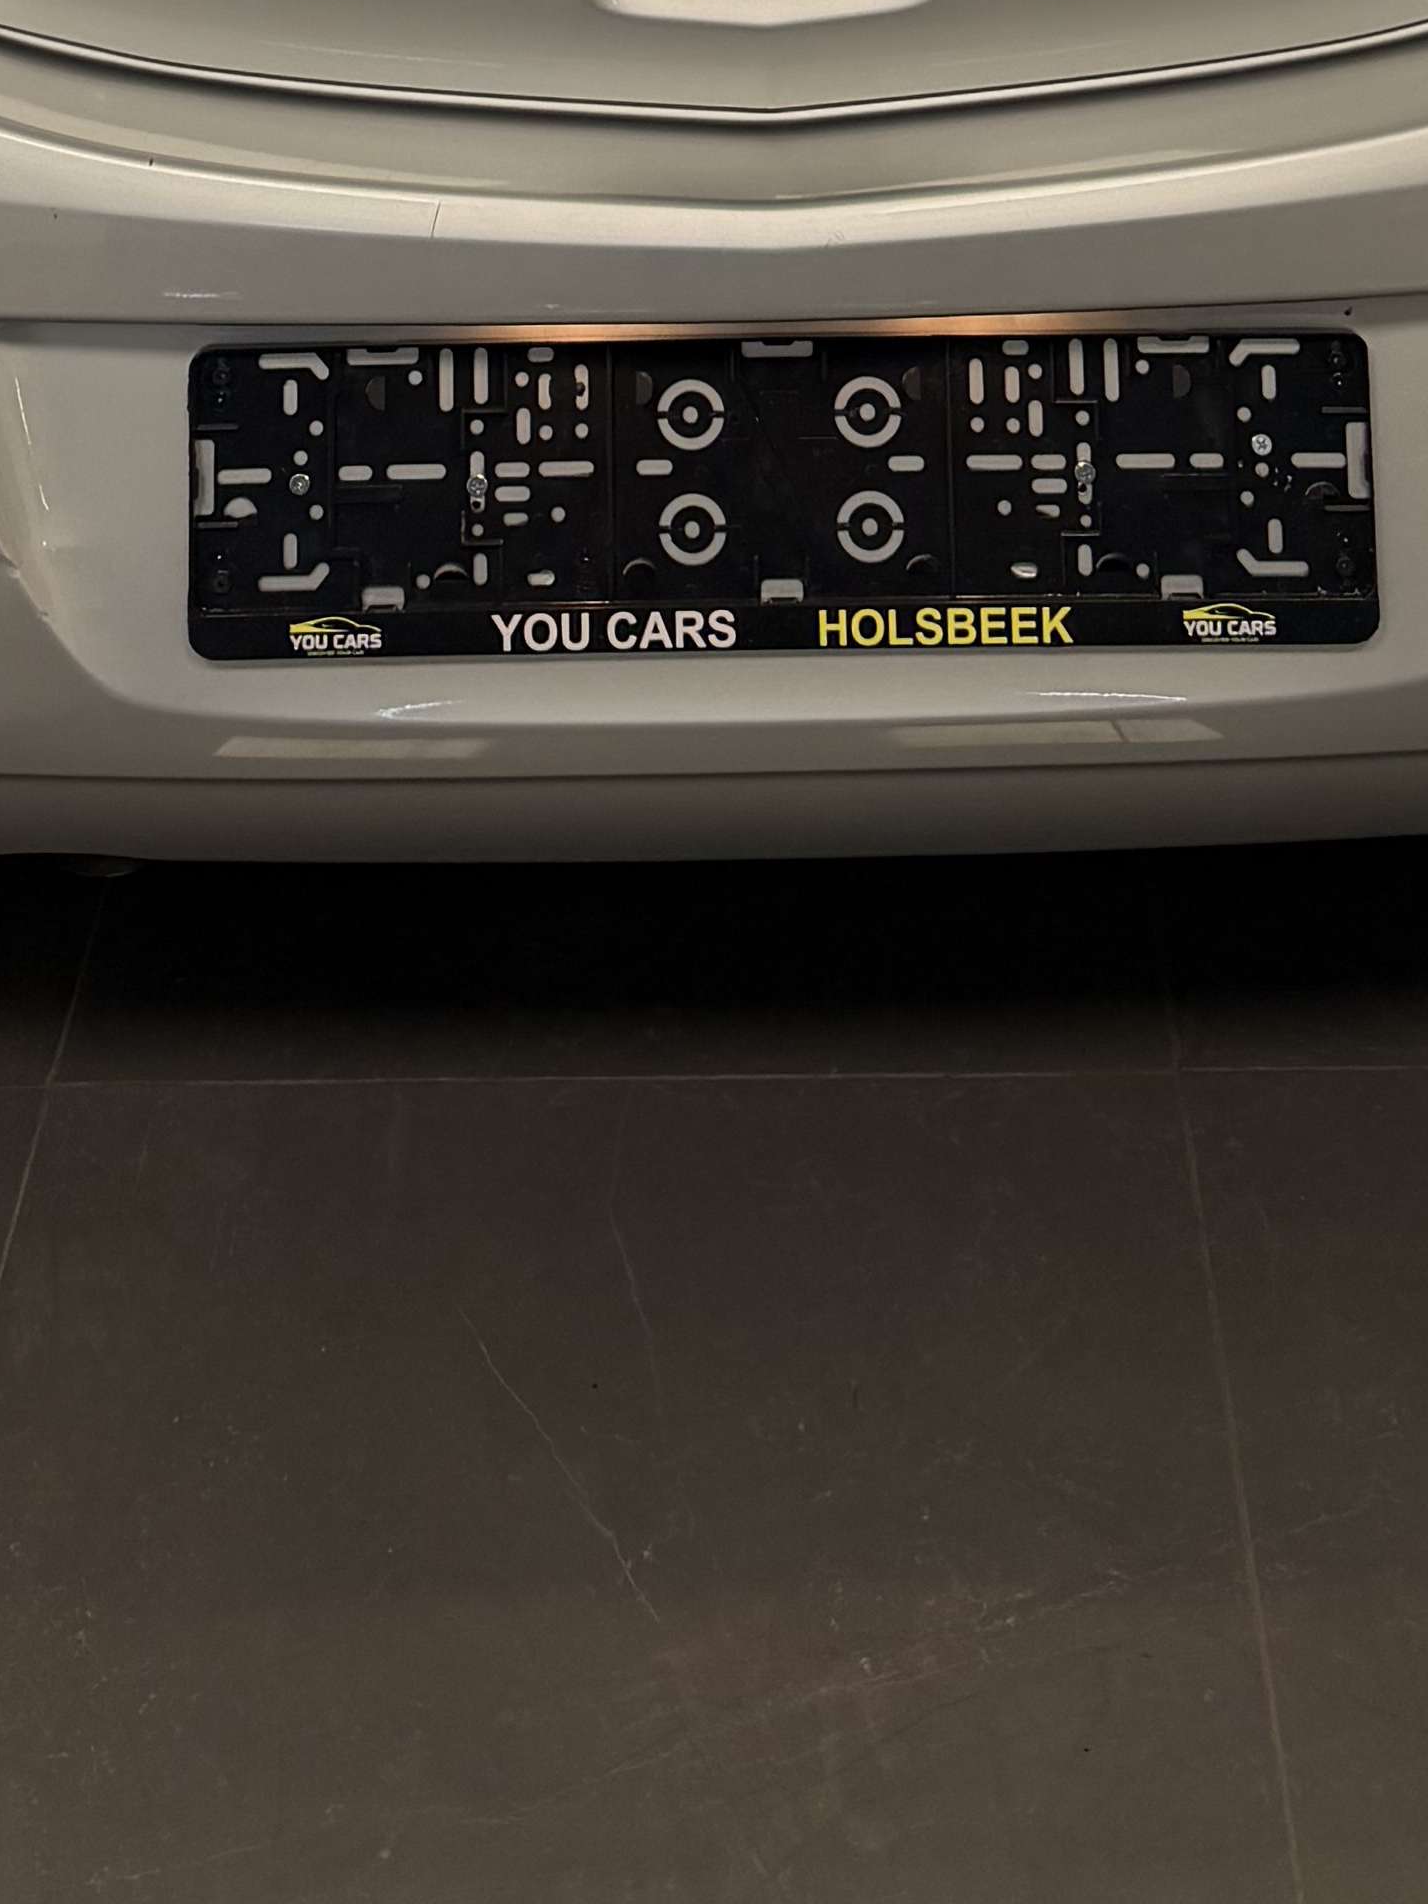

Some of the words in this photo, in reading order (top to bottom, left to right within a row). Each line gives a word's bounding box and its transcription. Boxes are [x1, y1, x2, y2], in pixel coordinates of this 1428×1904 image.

[491, 612, 591, 652] YOU
[606, 609, 737, 649] CARS
[818, 606, 1074, 646] HOLSBEEK
[1183, 619, 1223, 637] YOU
[1226, 619, 1278, 637] CARS
[289, 633, 329, 651] YOU
[332, 632, 383, 650] CARS
